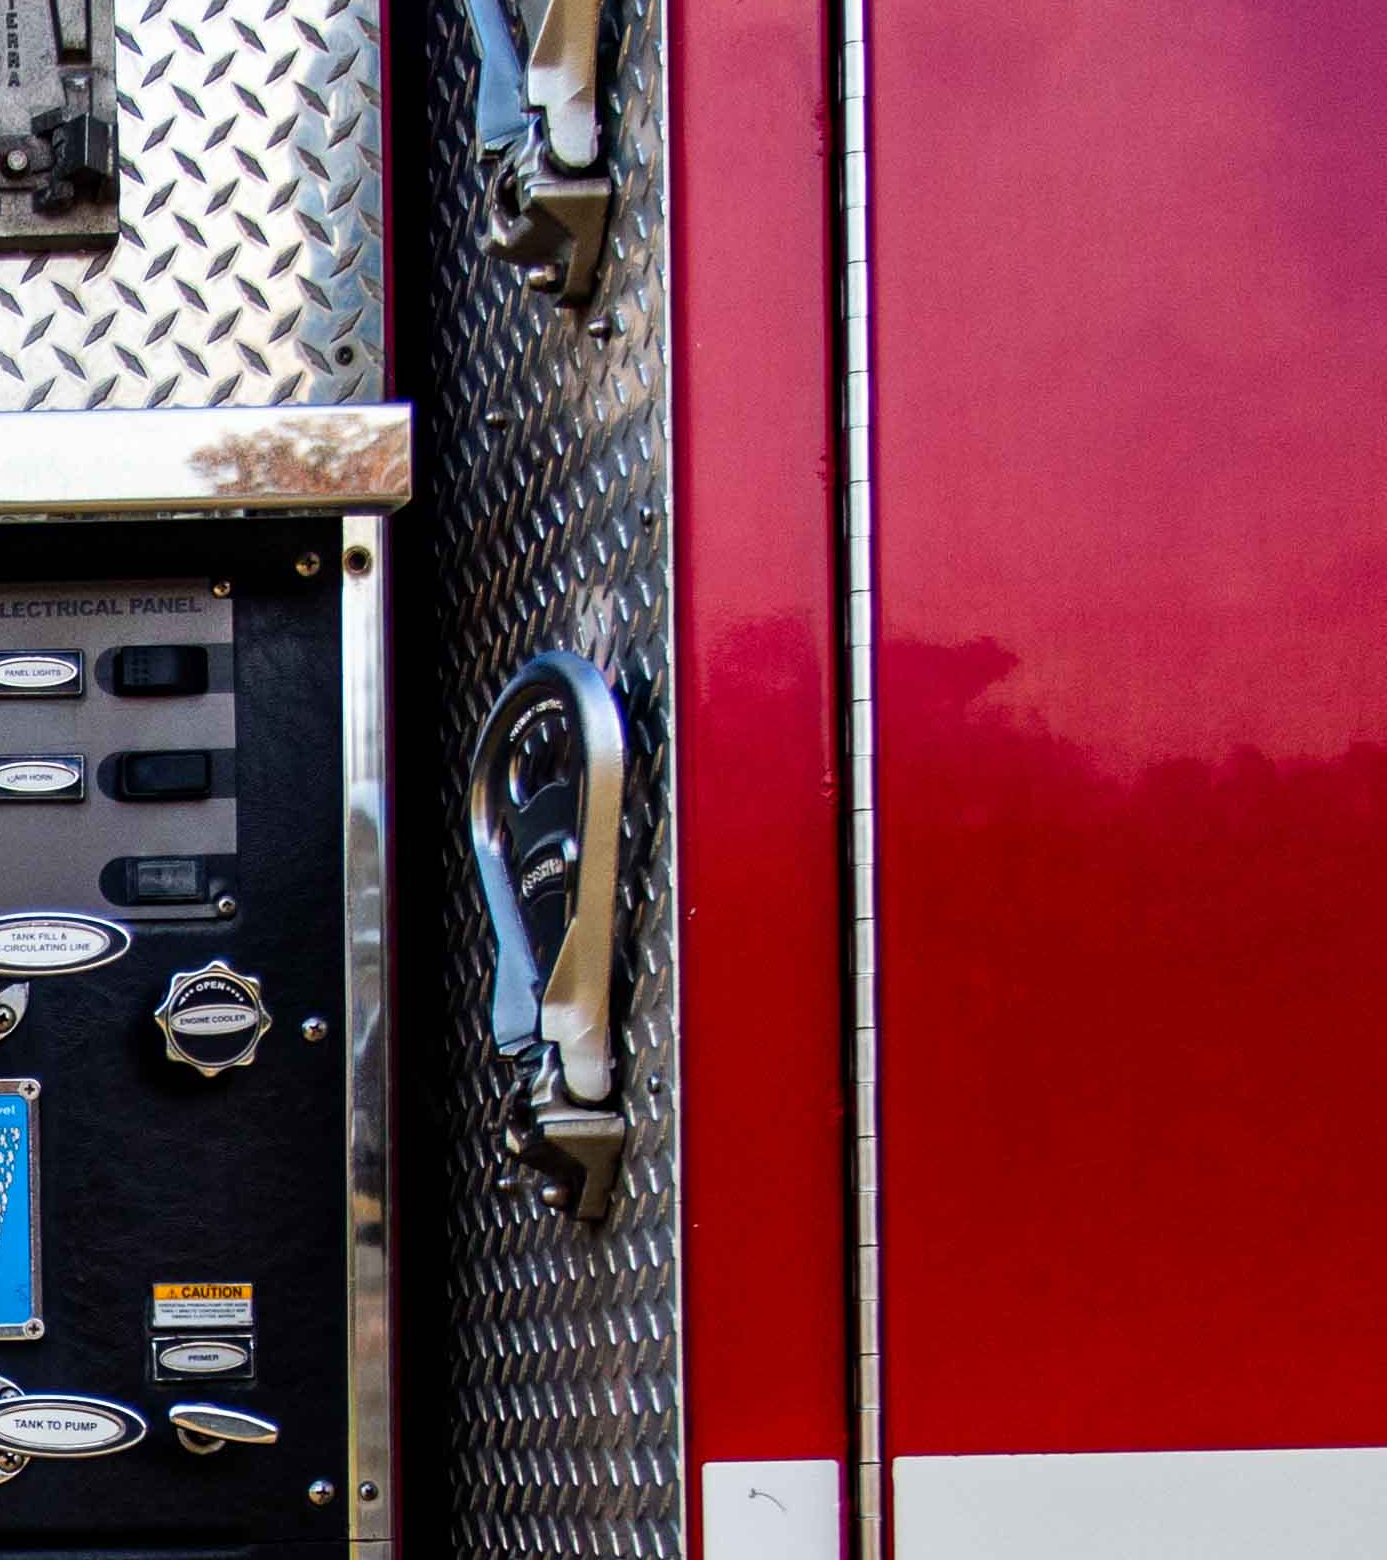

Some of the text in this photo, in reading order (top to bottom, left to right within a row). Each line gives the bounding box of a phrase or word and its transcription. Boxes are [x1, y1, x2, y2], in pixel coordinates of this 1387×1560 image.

[129, 597, 202, 614] PANEL
[11, 933, 36, 941] TANK
[38, 933, 57, 941] FILL
[70, 942, 91, 951] LINE
[196, 980, 225, 991] OPEN
[179, 1014, 246, 1025] ENGINE COOLER
[182, 1287, 242, 1298] CAUTION
[13, 1418, 98, 1432] TANK TO PUMP
